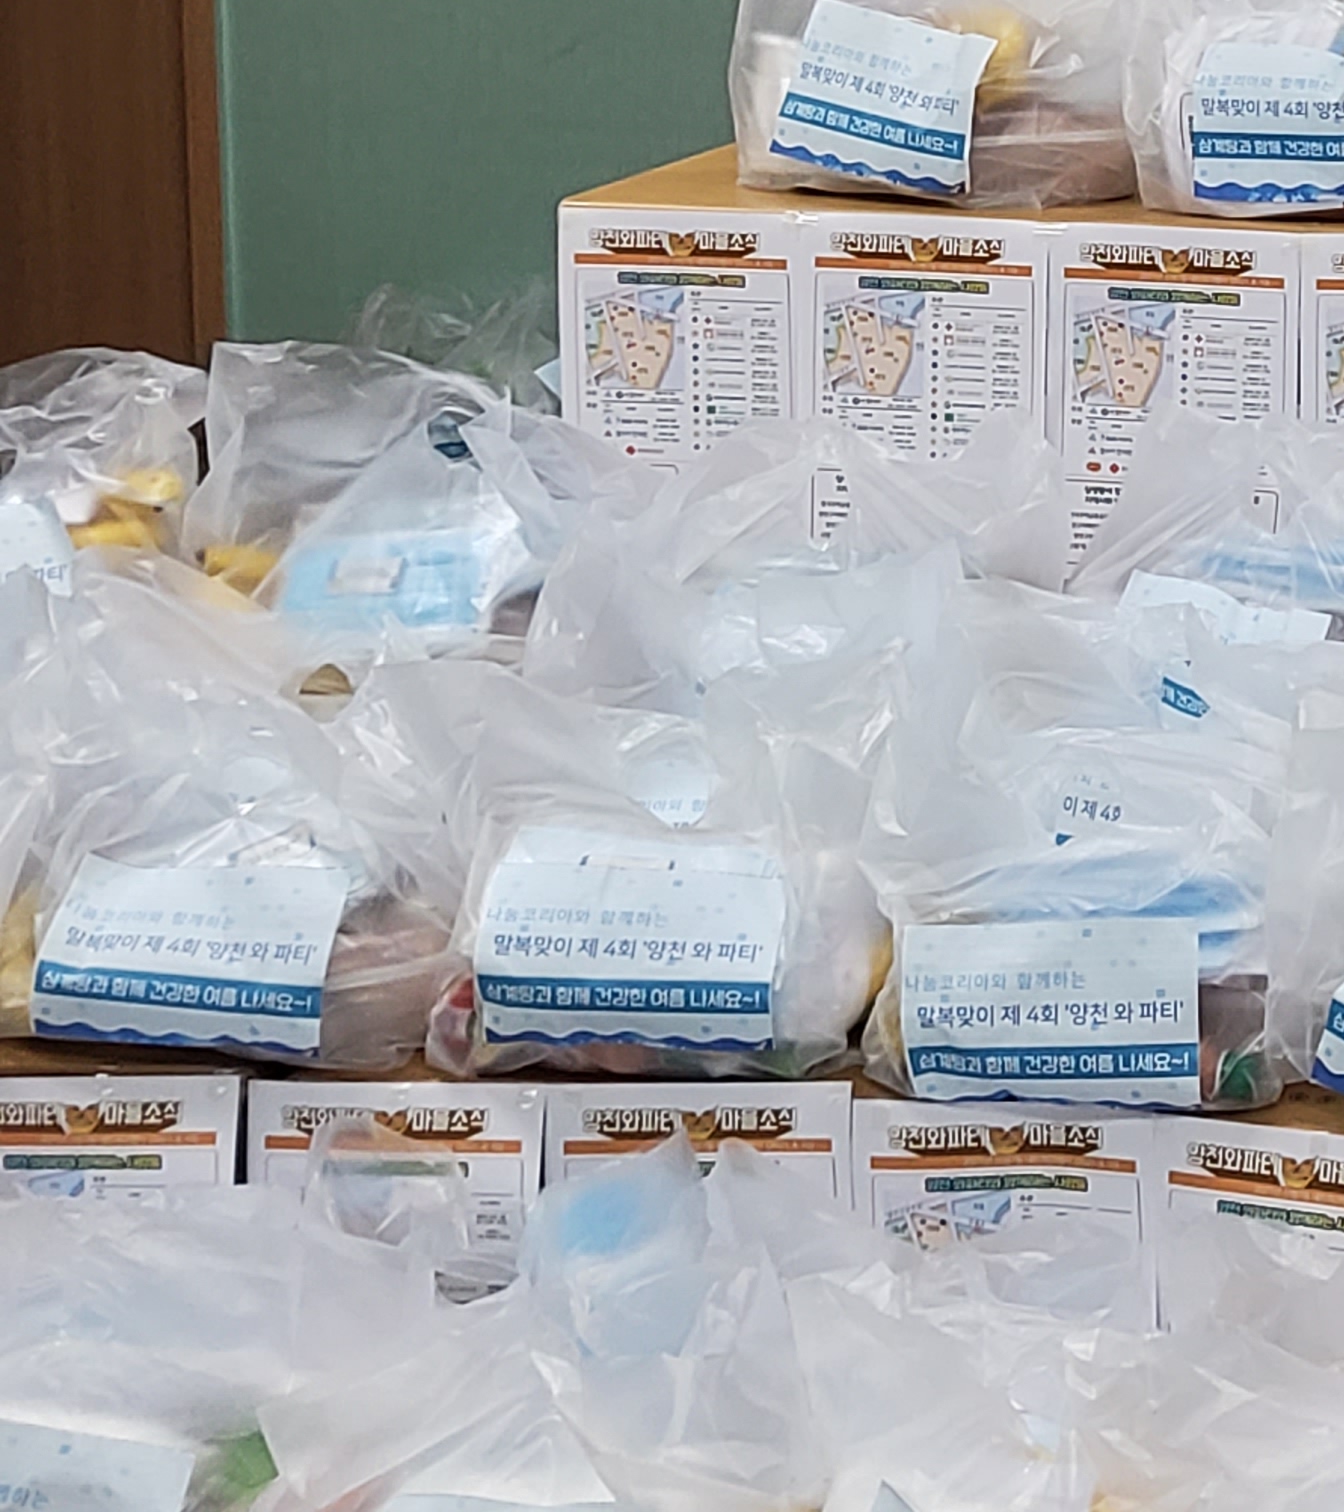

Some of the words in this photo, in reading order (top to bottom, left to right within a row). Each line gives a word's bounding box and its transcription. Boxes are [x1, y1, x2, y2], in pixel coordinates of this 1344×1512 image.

[1201, 98, 1261, 118] 말복맞이
[1264, 99, 1280, 118] 제
[1283, 100, 1309, 119] 4회
[494, 934, 573, 957] 말복맞이
[578, 937, 598, 958] 제
[602, 938, 637, 959] 4회
[691, 940, 712, 962] 와
[916, 1004, 996, 1029] 말복맞이
[1000, 1004, 1021, 1026] 제
[1026, 1003, 1060, 1026] 4회
[1112, 1002, 1134, 1022] 와
